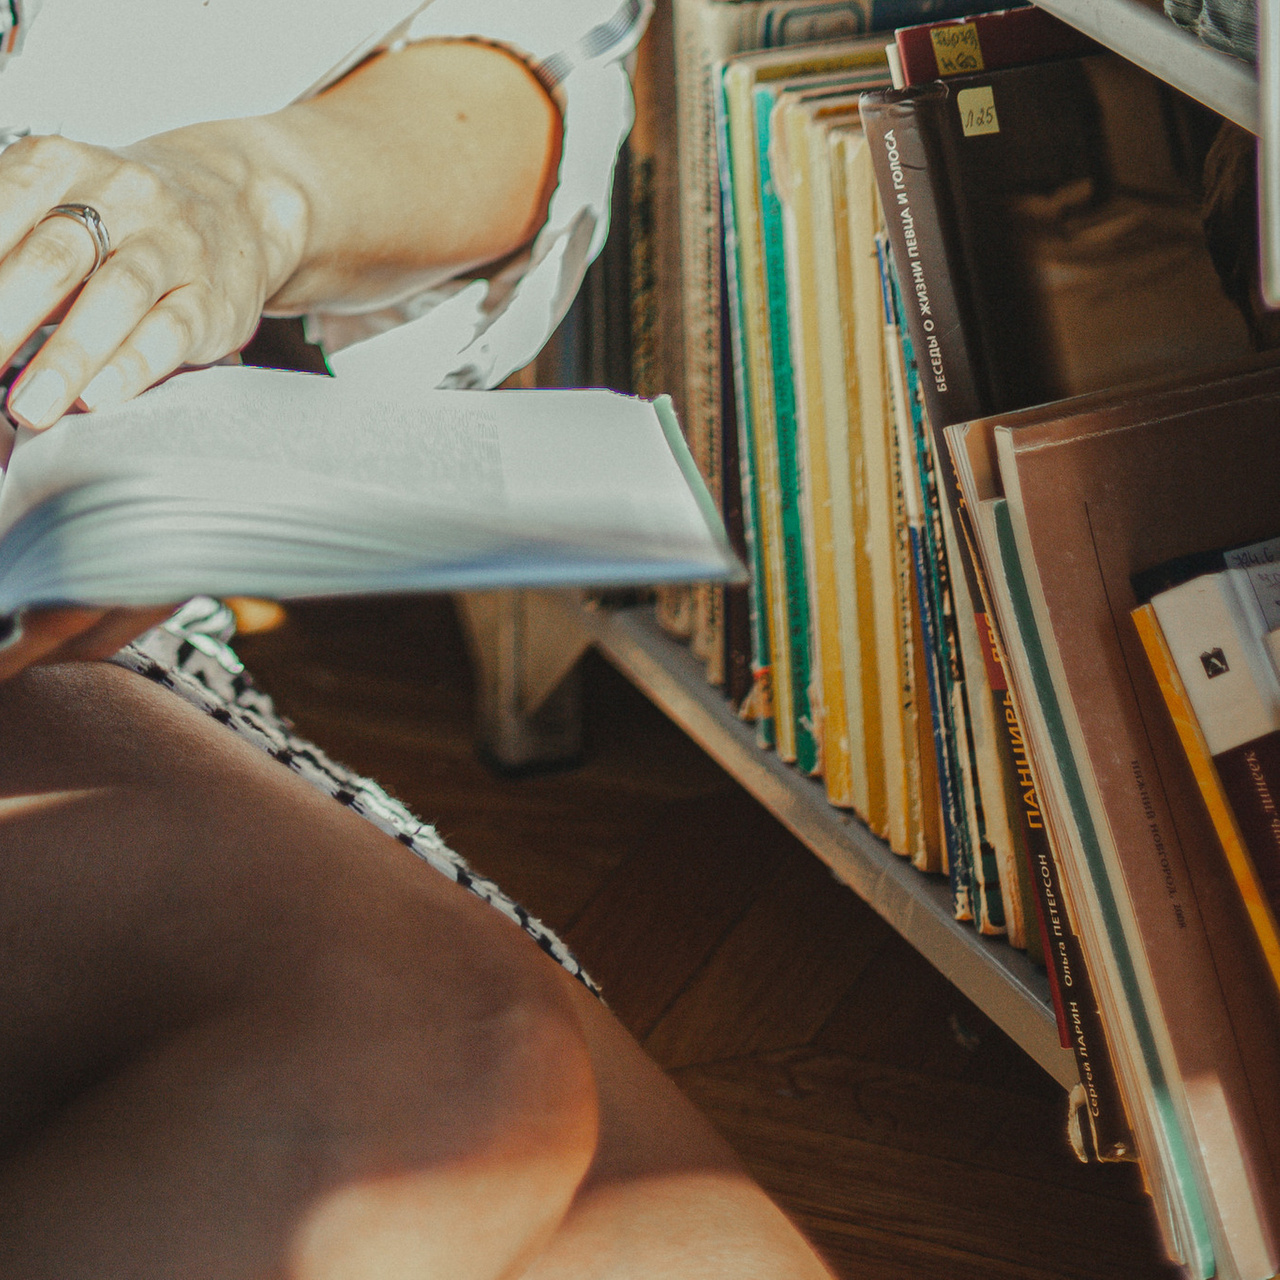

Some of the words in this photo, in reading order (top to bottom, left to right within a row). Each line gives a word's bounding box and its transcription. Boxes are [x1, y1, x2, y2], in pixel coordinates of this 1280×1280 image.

[884, 129, 905, 190] ГОЛОСА
[898, 190, 909, 202] И
[903, 207, 920, 259] ПЕВЦА
[913, 261, 931, 316] ЖИЗНИ
[923, 319, 935, 332] О
[928, 335, 948, 392] БЕСЕДЫ
[984, 612, 1002, 664] ДЛ
[1003, 697, 1044, 830] ПАНЦИРЬ
[1129, 759, 1157, 820] НИЖНИЙ
[1148, 822, 1179, 900] НОВГОРОД,
[1037, 852, 1063, 938] ПЕТЕРСОН
[1057, 941, 1074, 987] Ольга
[1068, 999, 1089, 1058] ЛАРИН
[1080, 1061, 1101, 1118] Сергей
